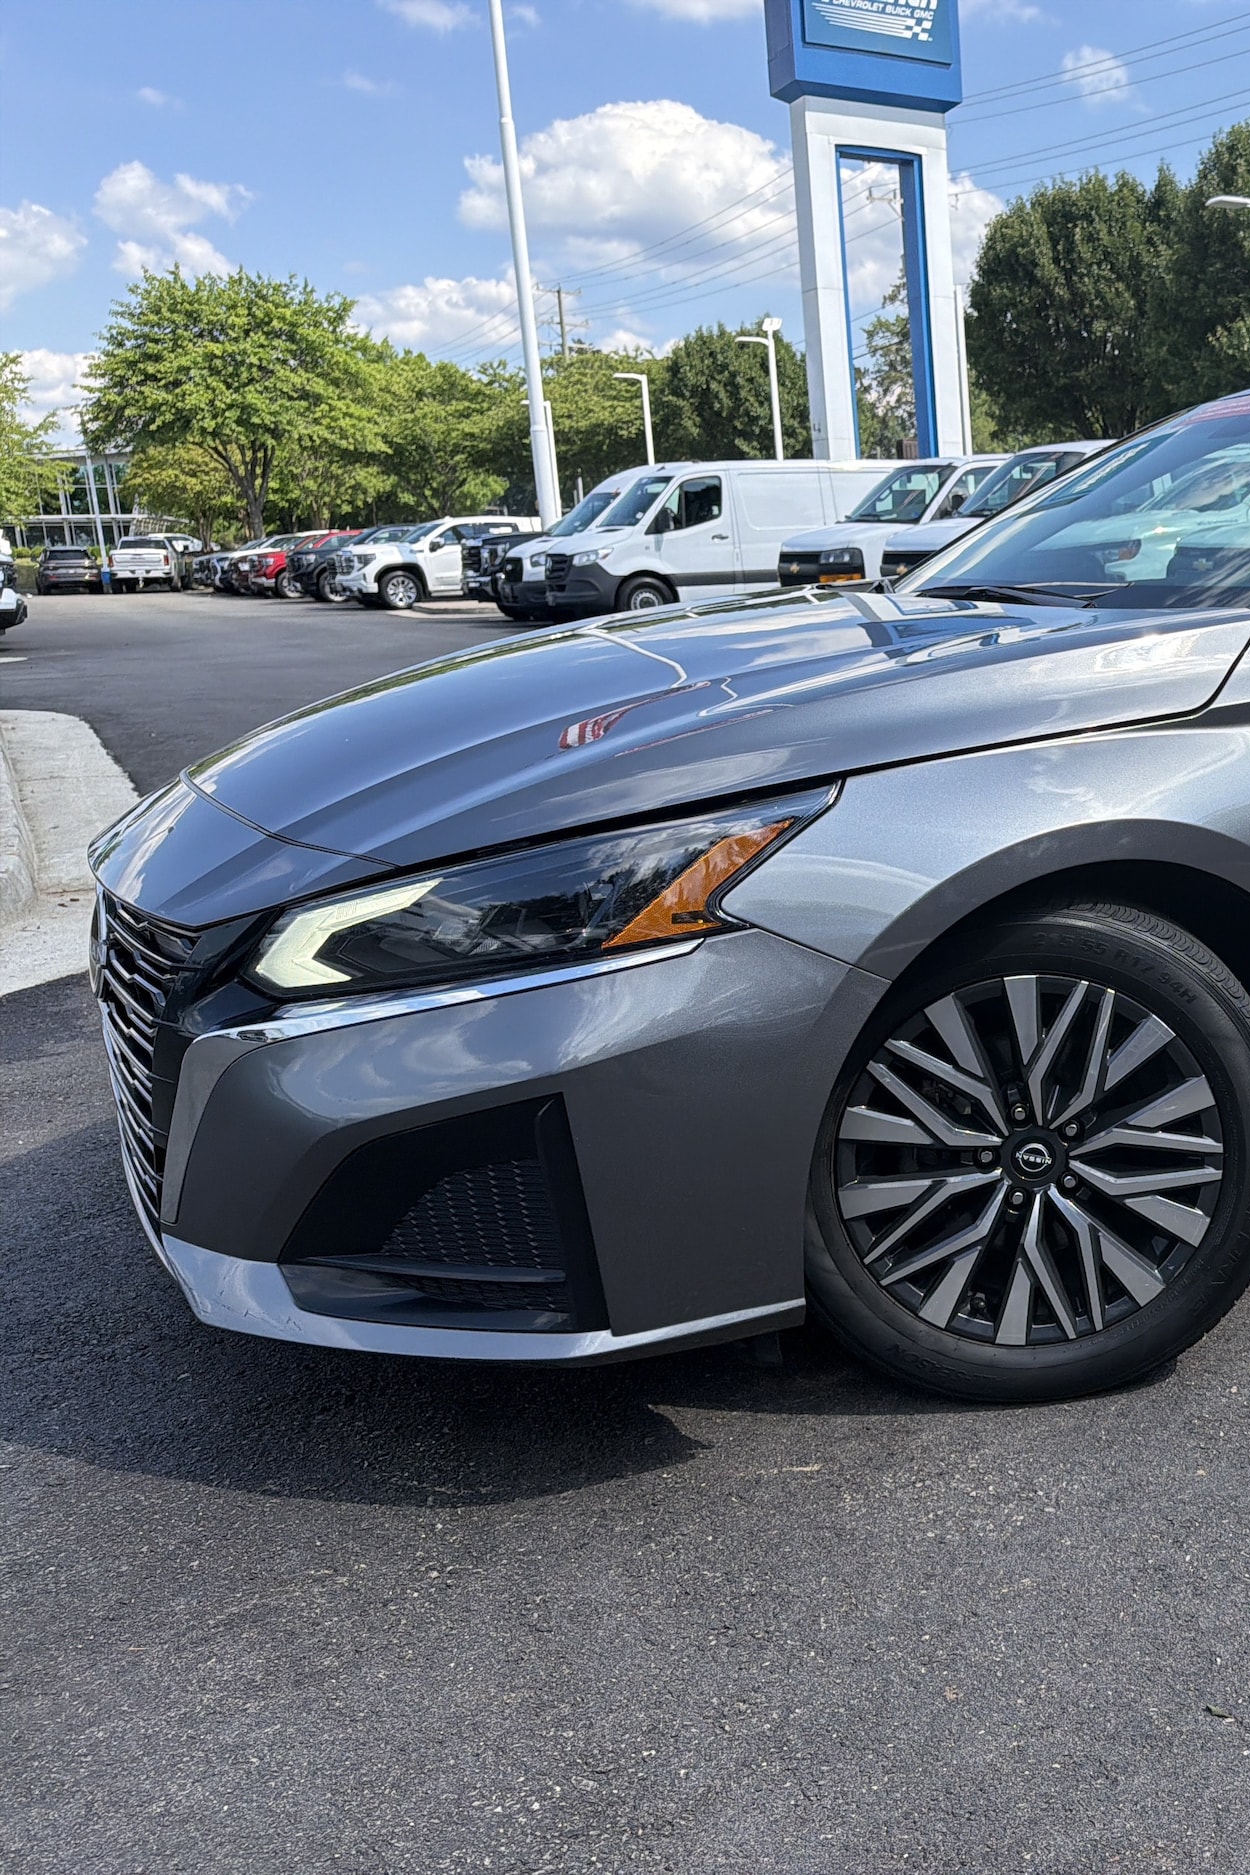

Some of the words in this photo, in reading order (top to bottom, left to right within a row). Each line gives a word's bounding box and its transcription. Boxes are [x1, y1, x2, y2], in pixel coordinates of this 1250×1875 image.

[833, 0, 883, 12] CHEVROLET
[885, 5, 912, 17] BUICK
[913, 9, 935, 20] GMC
[1015, 1151, 1052, 1165] NISSAN
